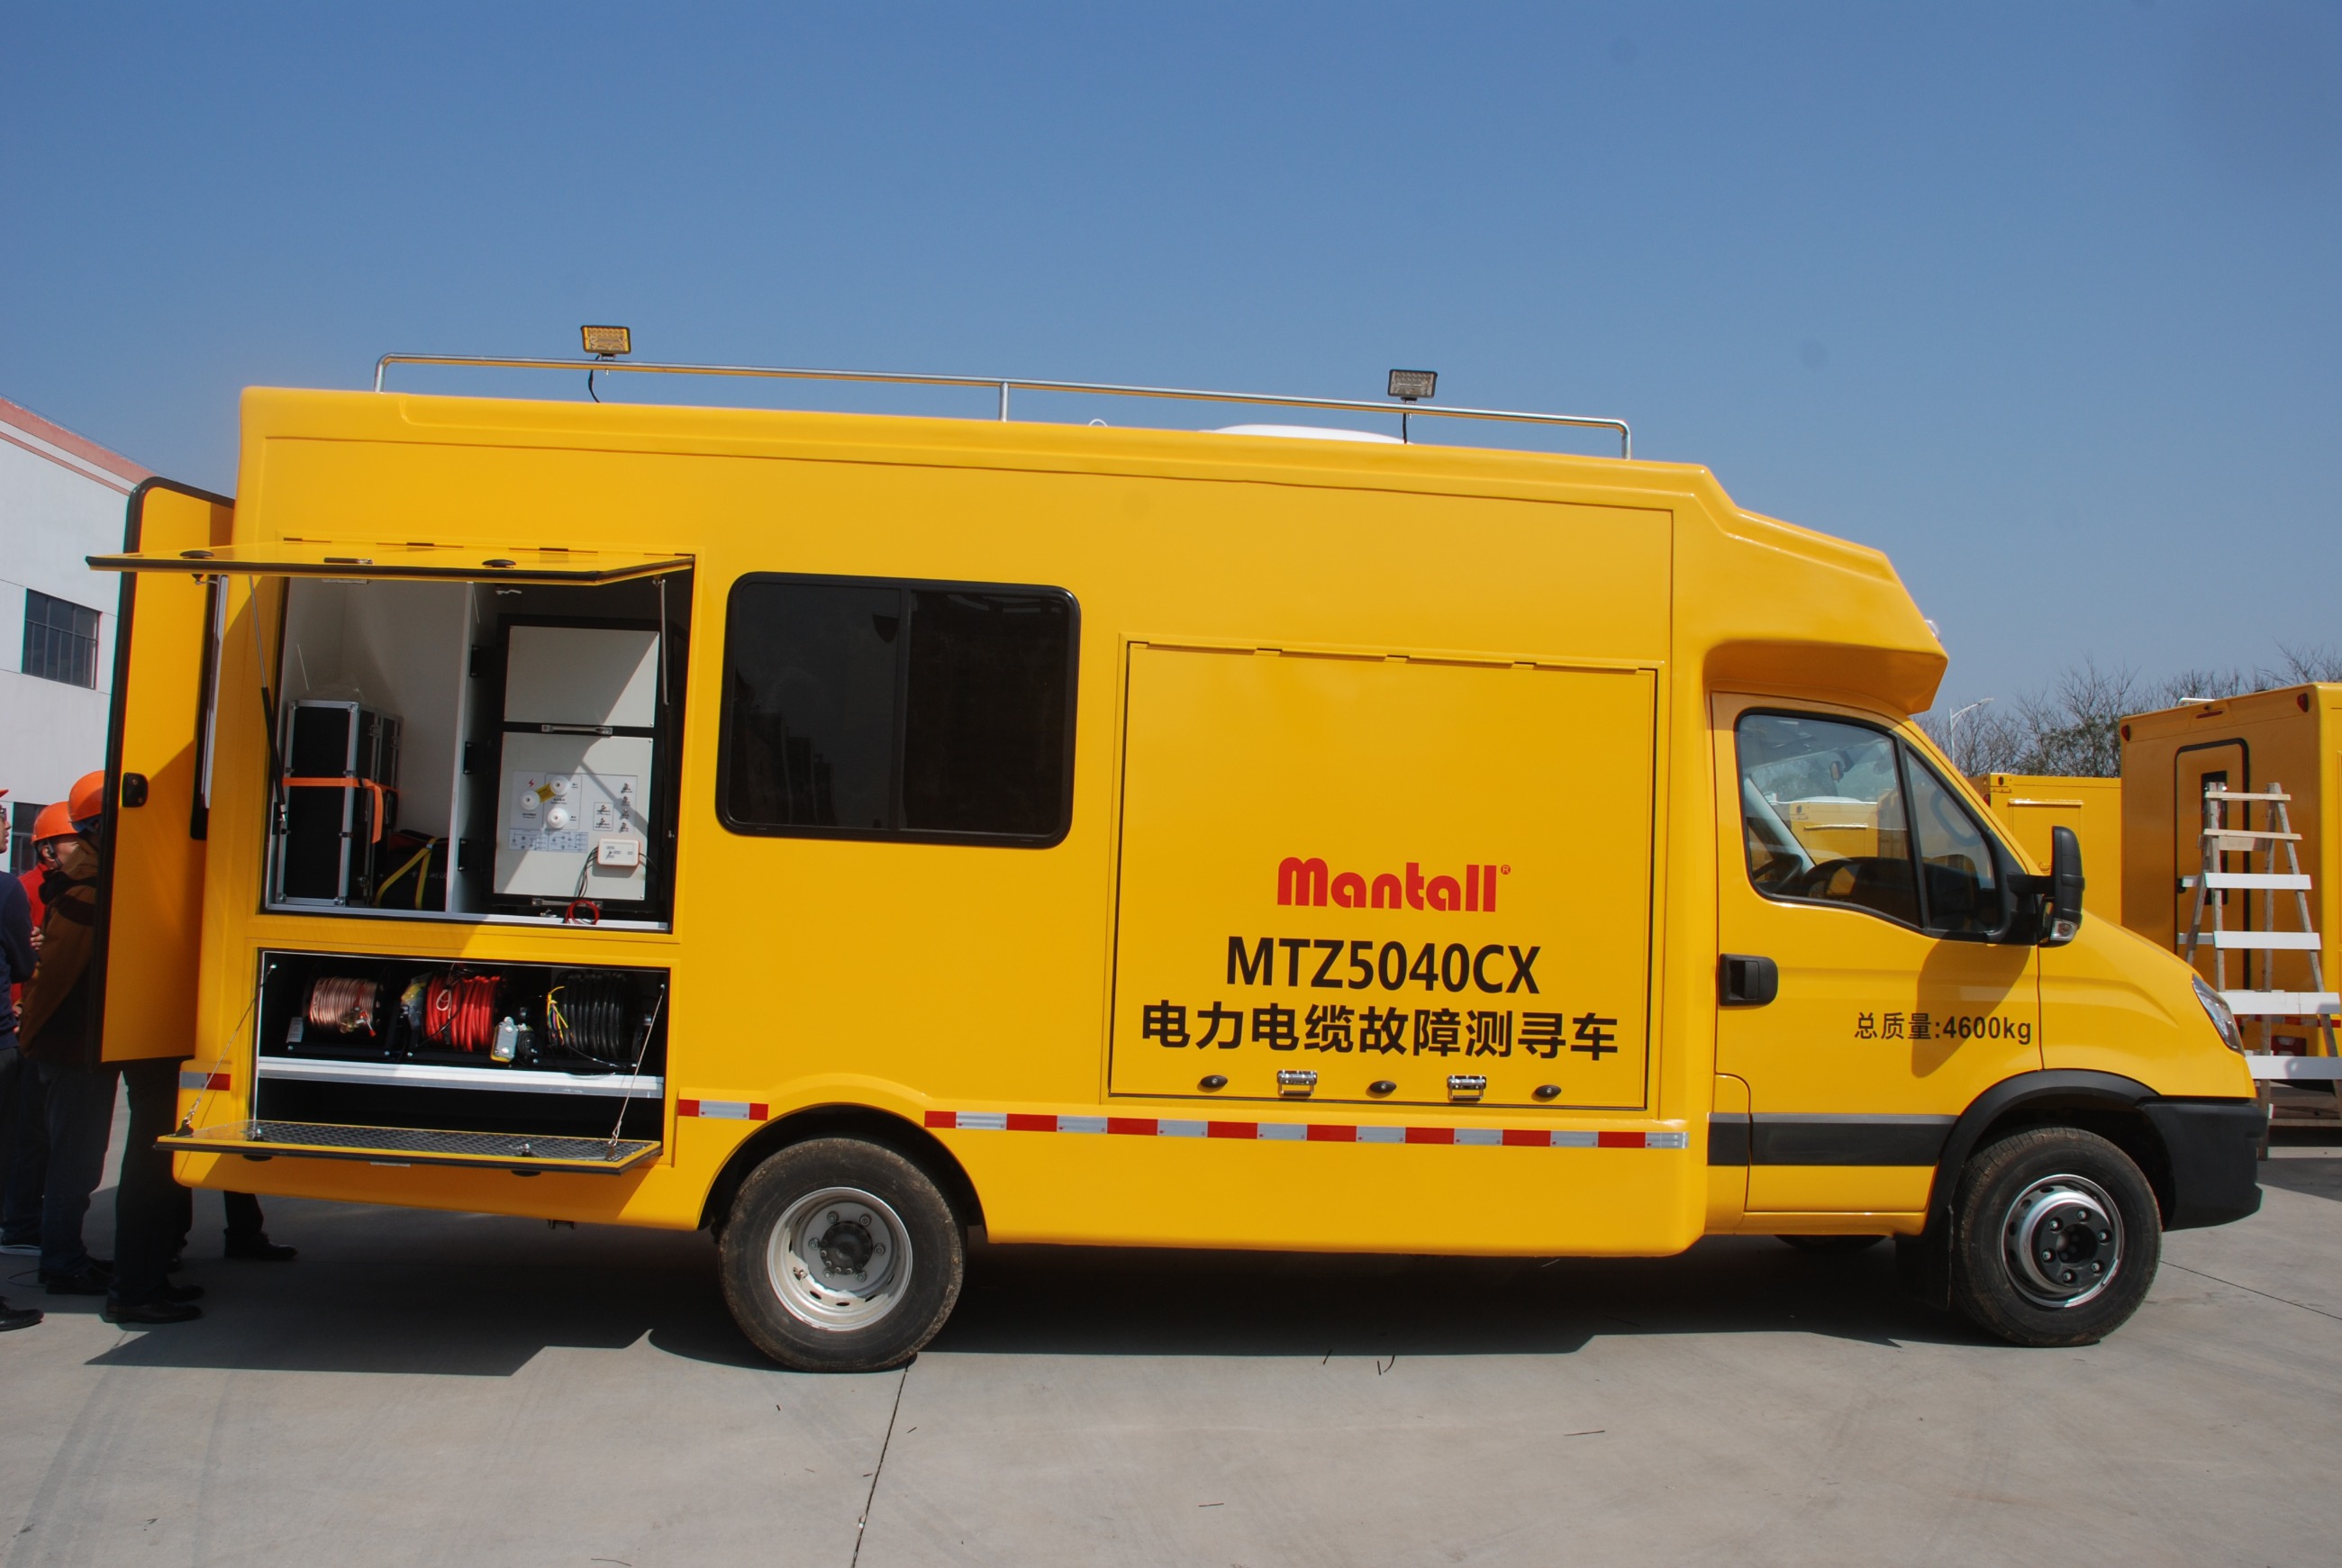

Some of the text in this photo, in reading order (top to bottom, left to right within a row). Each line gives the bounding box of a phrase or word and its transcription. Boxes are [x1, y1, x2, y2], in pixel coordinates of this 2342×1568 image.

[1227, 936, 1541, 994] MTZ5040CX
[1141, 999, 1619, 1061] 电力电缆故障测寻车
